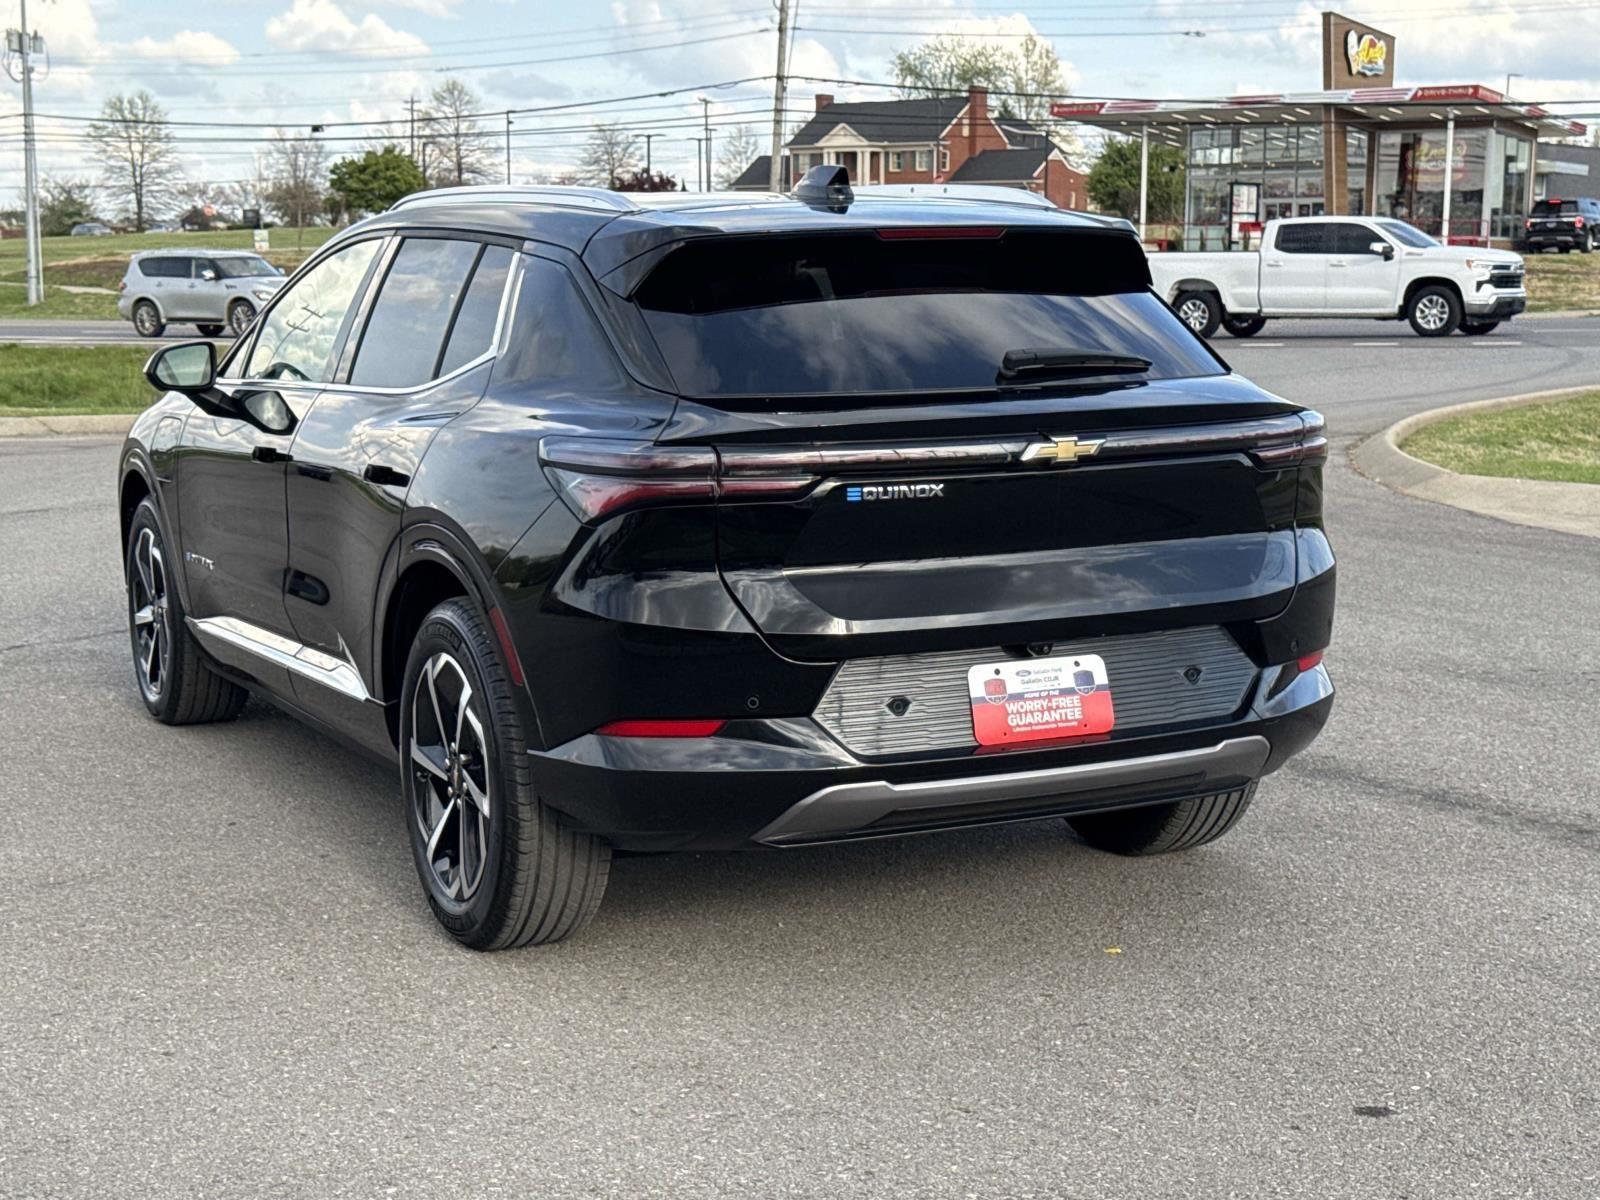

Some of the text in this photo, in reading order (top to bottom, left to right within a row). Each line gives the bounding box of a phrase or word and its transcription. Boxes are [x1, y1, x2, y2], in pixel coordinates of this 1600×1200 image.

[847, 483, 944, 501] EQUINOX
[1005, 696, 1081, 714] WORRY-FREE
[1007, 708, 1083, 726] GUARANTEE
